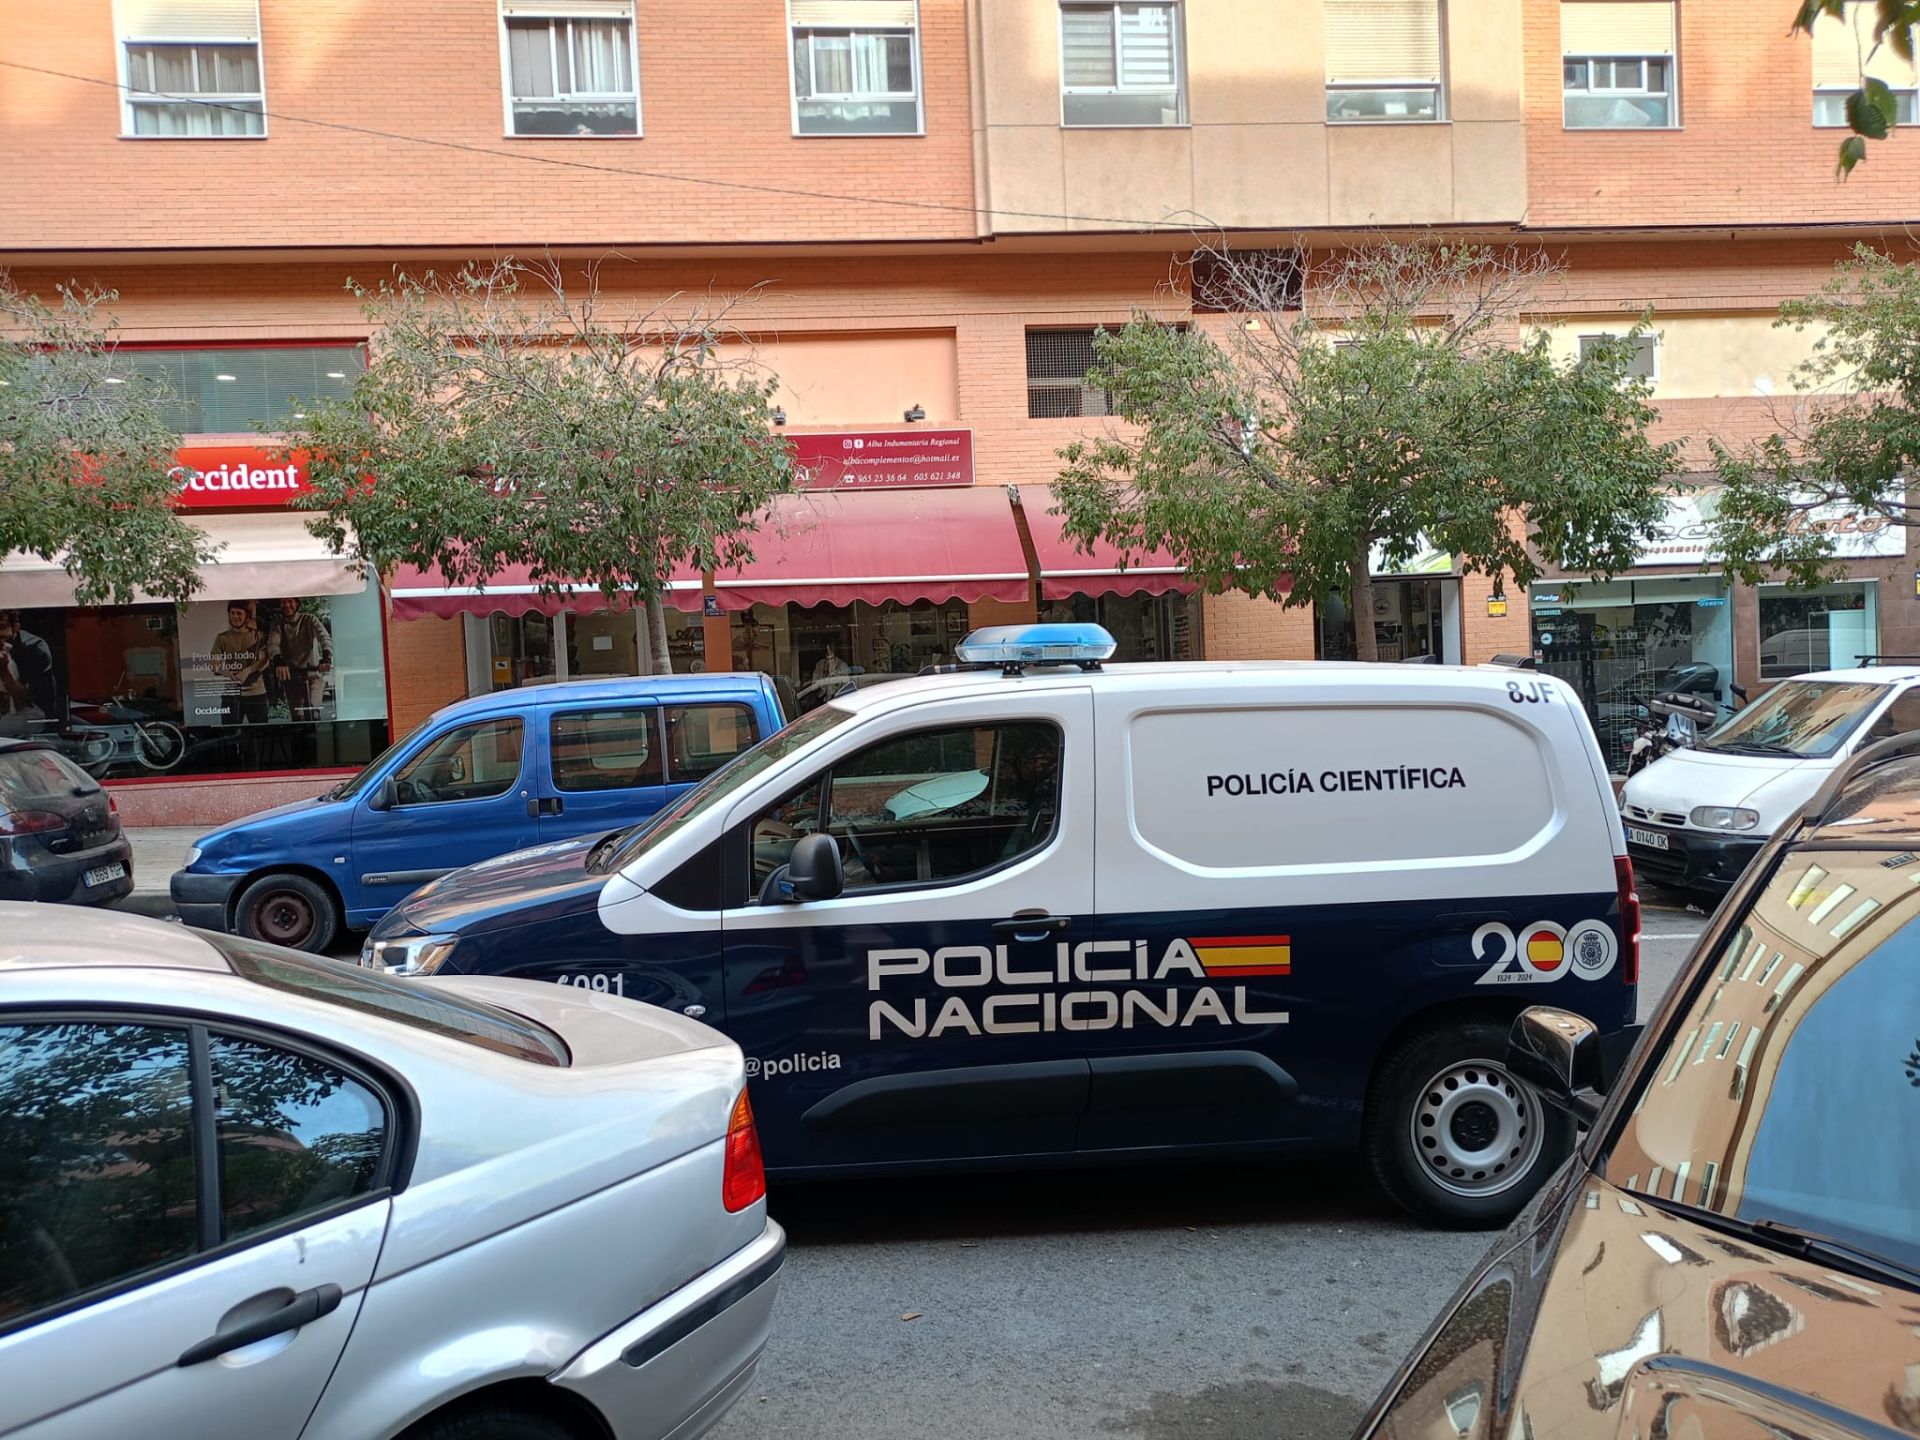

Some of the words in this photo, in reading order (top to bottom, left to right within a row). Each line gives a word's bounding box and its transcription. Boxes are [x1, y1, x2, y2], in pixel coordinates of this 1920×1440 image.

[866, 440, 884, 448] Alba
[884, 439, 928, 448] Indumentaria
[930, 437, 960, 448] Regional
[873, 474, 884, 482] 25
[886, 473, 896, 482] 36
[897, 472, 907, 482] 64
[914, 472, 928, 481] 605
[930, 472, 944, 480] 621
[946, 472, 961, 480] 348
[192, 651, 232, 662] Probarlo
[234, 650, 257, 660] todo,
[192, 663, 213, 672] todo
[1505, 680, 1554, 704] 8JF
[194, 706, 231, 716] Occident
[1206, 768, 1314, 796] POLICÍA
[1320, 764, 1466, 793] CIENTÍFICA
[868, 986, 1290, 1041] NACIONAL
[744, 1051, 842, 1080] @policia
